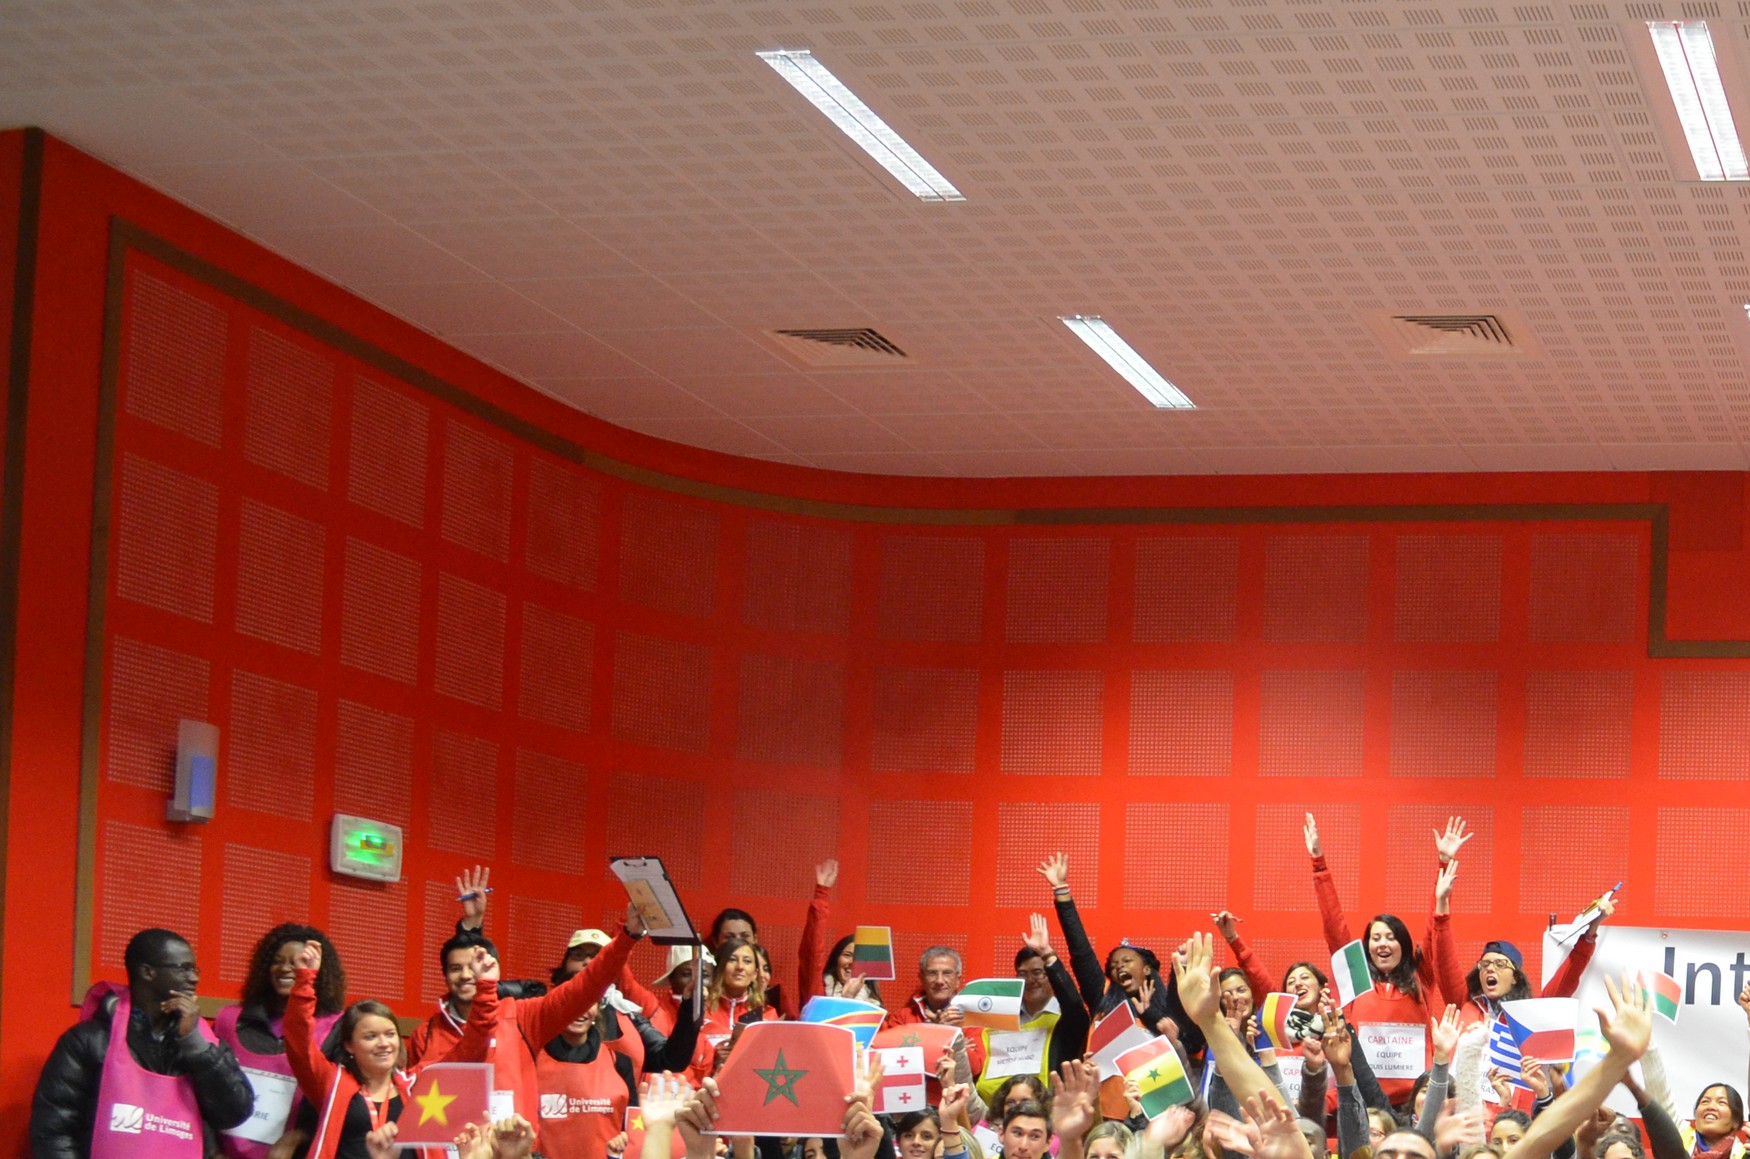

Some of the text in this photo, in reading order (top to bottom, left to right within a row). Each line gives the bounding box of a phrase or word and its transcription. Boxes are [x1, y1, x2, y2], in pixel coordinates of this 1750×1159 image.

[1368, 1035, 1414, 1045] CAPITAINE
[1376, 1051, 1403, 1059] EQUIPE
[1370, 1063, 1383, 1071] OUIS
[569, 1097, 611, 1106] Université
[582, 1106, 614, 1114] Limoges
[146, 1113, 191, 1131] Université
[144, 1122, 194, 1140] de Limoges
